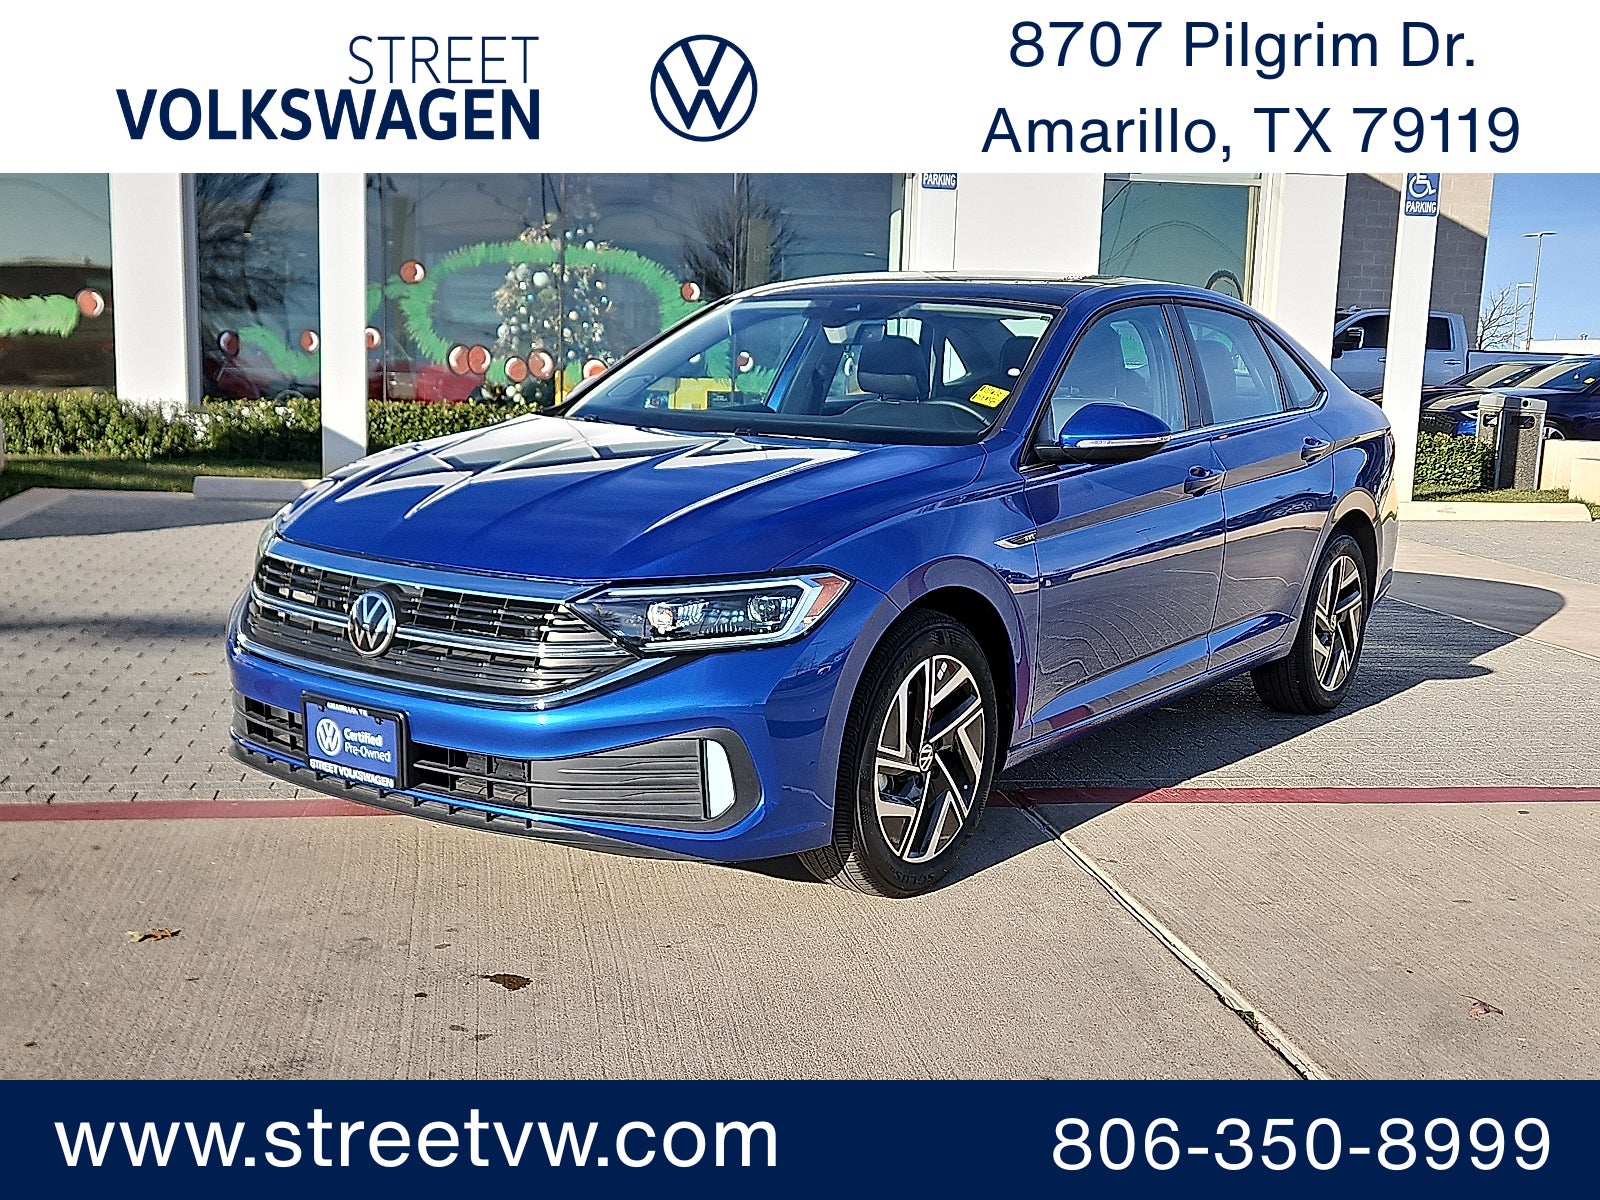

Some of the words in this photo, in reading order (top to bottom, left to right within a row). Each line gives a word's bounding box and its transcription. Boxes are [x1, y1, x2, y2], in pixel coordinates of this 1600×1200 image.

[923, 173, 956, 187] PARKING
[1406, 201, 1437, 213] PARKING
[343, 727, 383, 748] Certified
[344, 741, 392, 764] Pre-Owned
